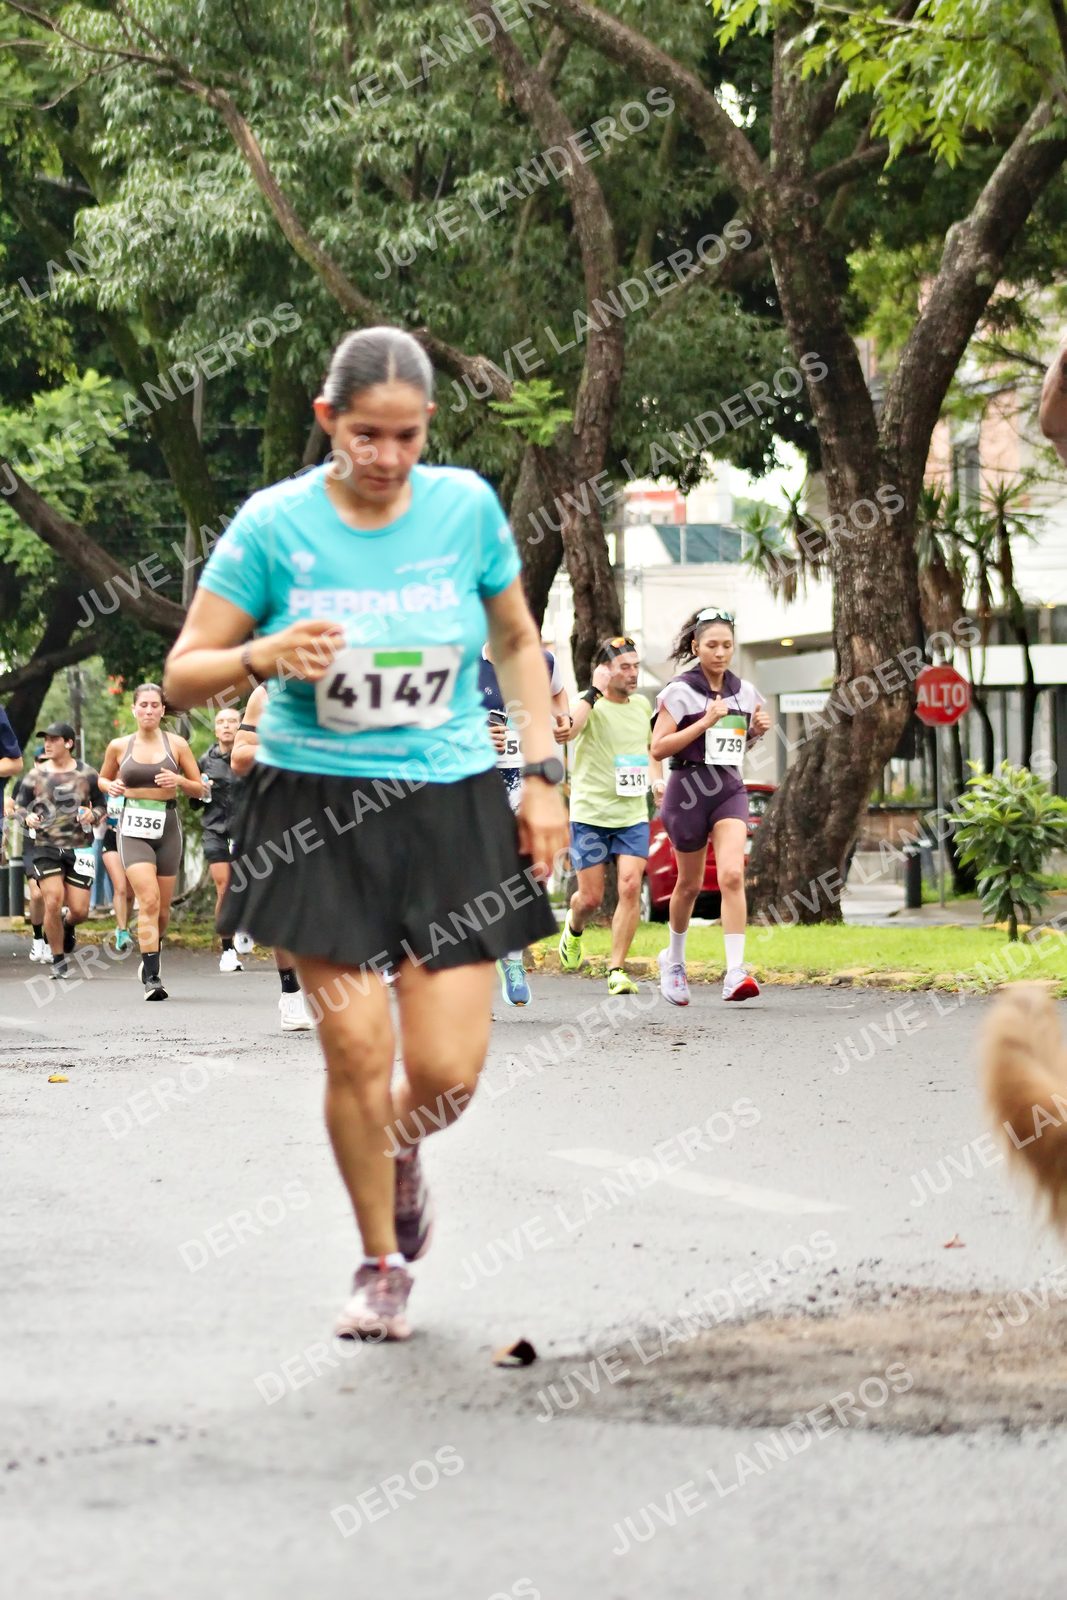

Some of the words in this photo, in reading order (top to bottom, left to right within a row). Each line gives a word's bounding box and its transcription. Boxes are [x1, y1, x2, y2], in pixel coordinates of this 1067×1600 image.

[327, 668, 450, 710] 4147
[916, 683, 966, 708] ALTO
[716, 738, 743, 752] 739
[127, 815, 162, 830] 1336
